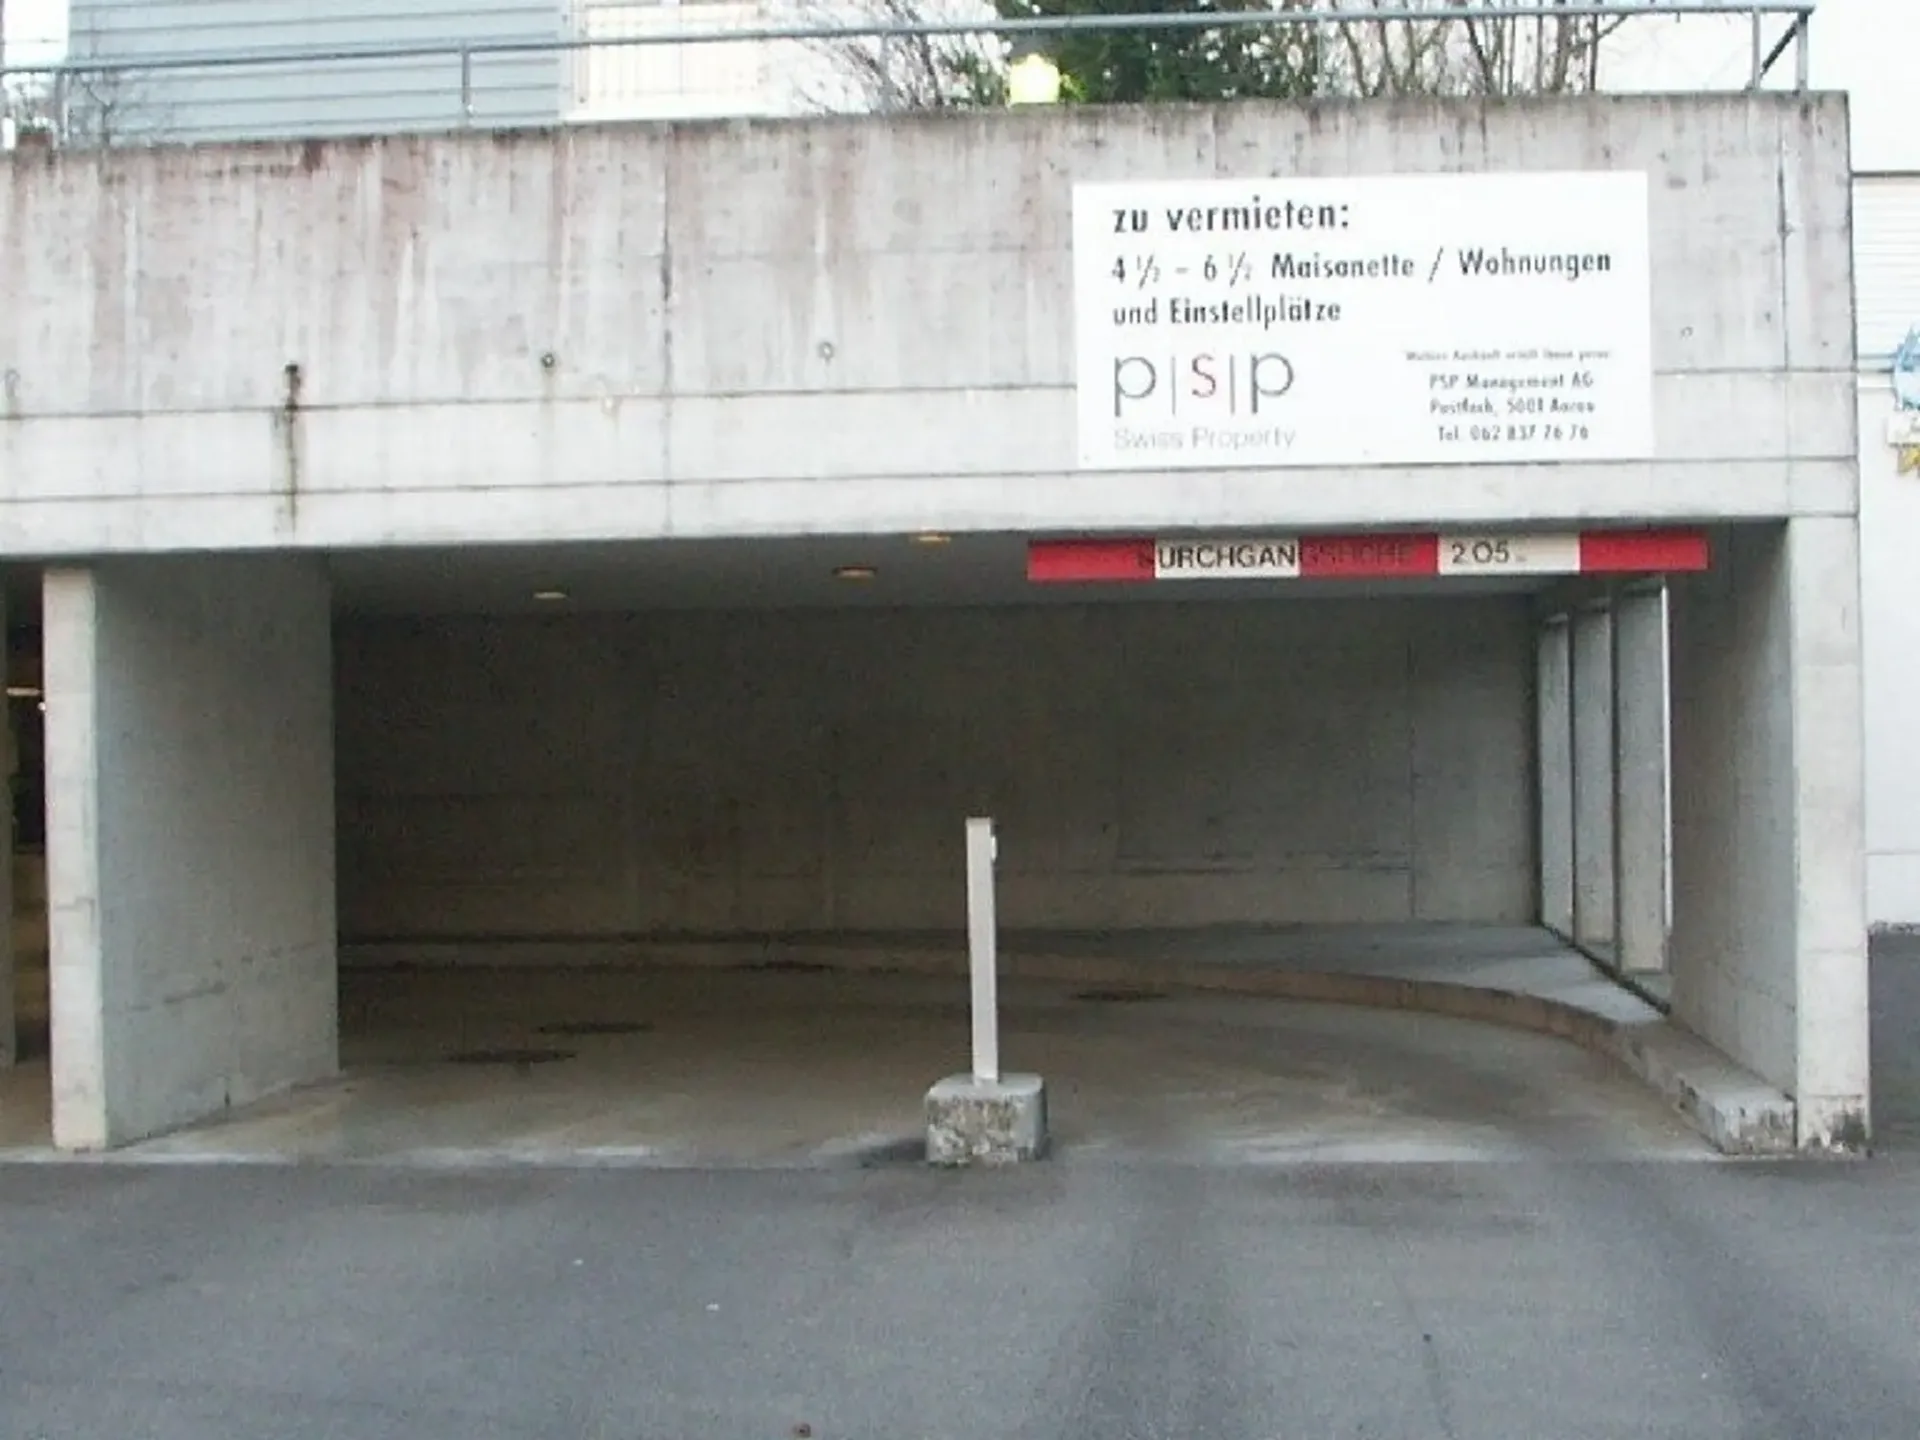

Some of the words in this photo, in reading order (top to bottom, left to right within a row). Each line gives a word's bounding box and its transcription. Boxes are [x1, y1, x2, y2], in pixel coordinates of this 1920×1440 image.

[1112, 208, 1149, 233] zu
[1166, 195, 1349, 232] vermieten:
[1112, 255, 1126, 283] 4
[1203, 254, 1218, 281] 6
[1271, 252, 1415, 279] Maisonette
[1428, 247, 1444, 283] /
[1458, 247, 1611, 281] Wohnungen
[1113, 297, 1158, 325] und
[1169, 294, 1342, 331] Einstellplätze
[1429, 373, 1459, 390] PSP
[1466, 372, 1564, 393] Management
[1571, 370, 1595, 388] AG
[1114, 427, 1184, 449] Swiss
[1191, 424, 1297, 451] Property
[1450, 541, 1511, 564] 205
